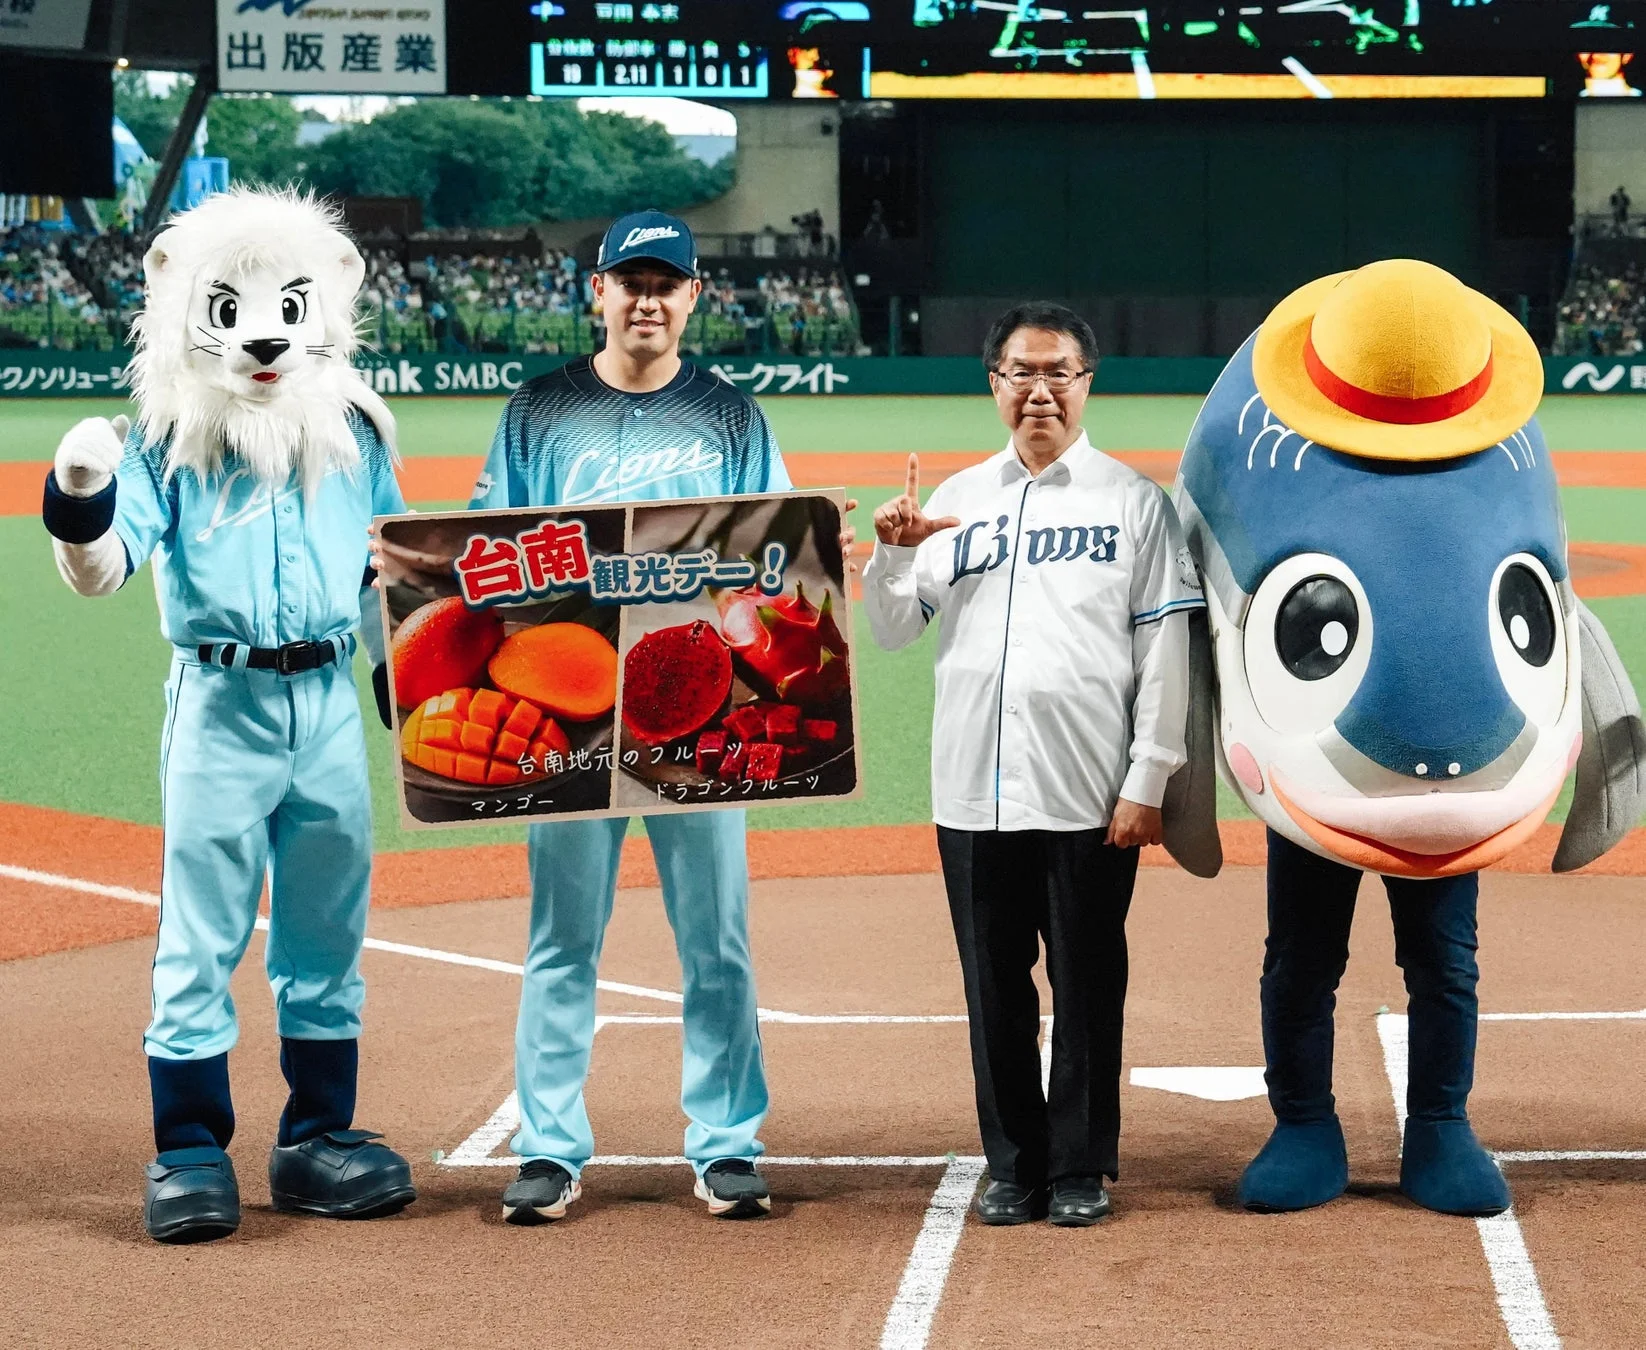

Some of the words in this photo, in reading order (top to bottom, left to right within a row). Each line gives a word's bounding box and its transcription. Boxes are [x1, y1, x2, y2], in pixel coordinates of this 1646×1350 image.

[226, 31, 437, 74] 出版産業
[614, 64, 648, 85] 2.11
[673, 64, 683, 85] 1
[740, 65, 750, 85] 1
[618, 225, 680, 252] Lions
[434, 361, 523, 391] SMBC
[561, 438, 724, 505] Lions
[948, 513, 1121, 588] Lions
[516, 742, 743, 775] 台南地元のフルーツ
[471, 793, 554, 813] マンゴー
[656, 775, 819, 801] ドラゴンフルーツ
